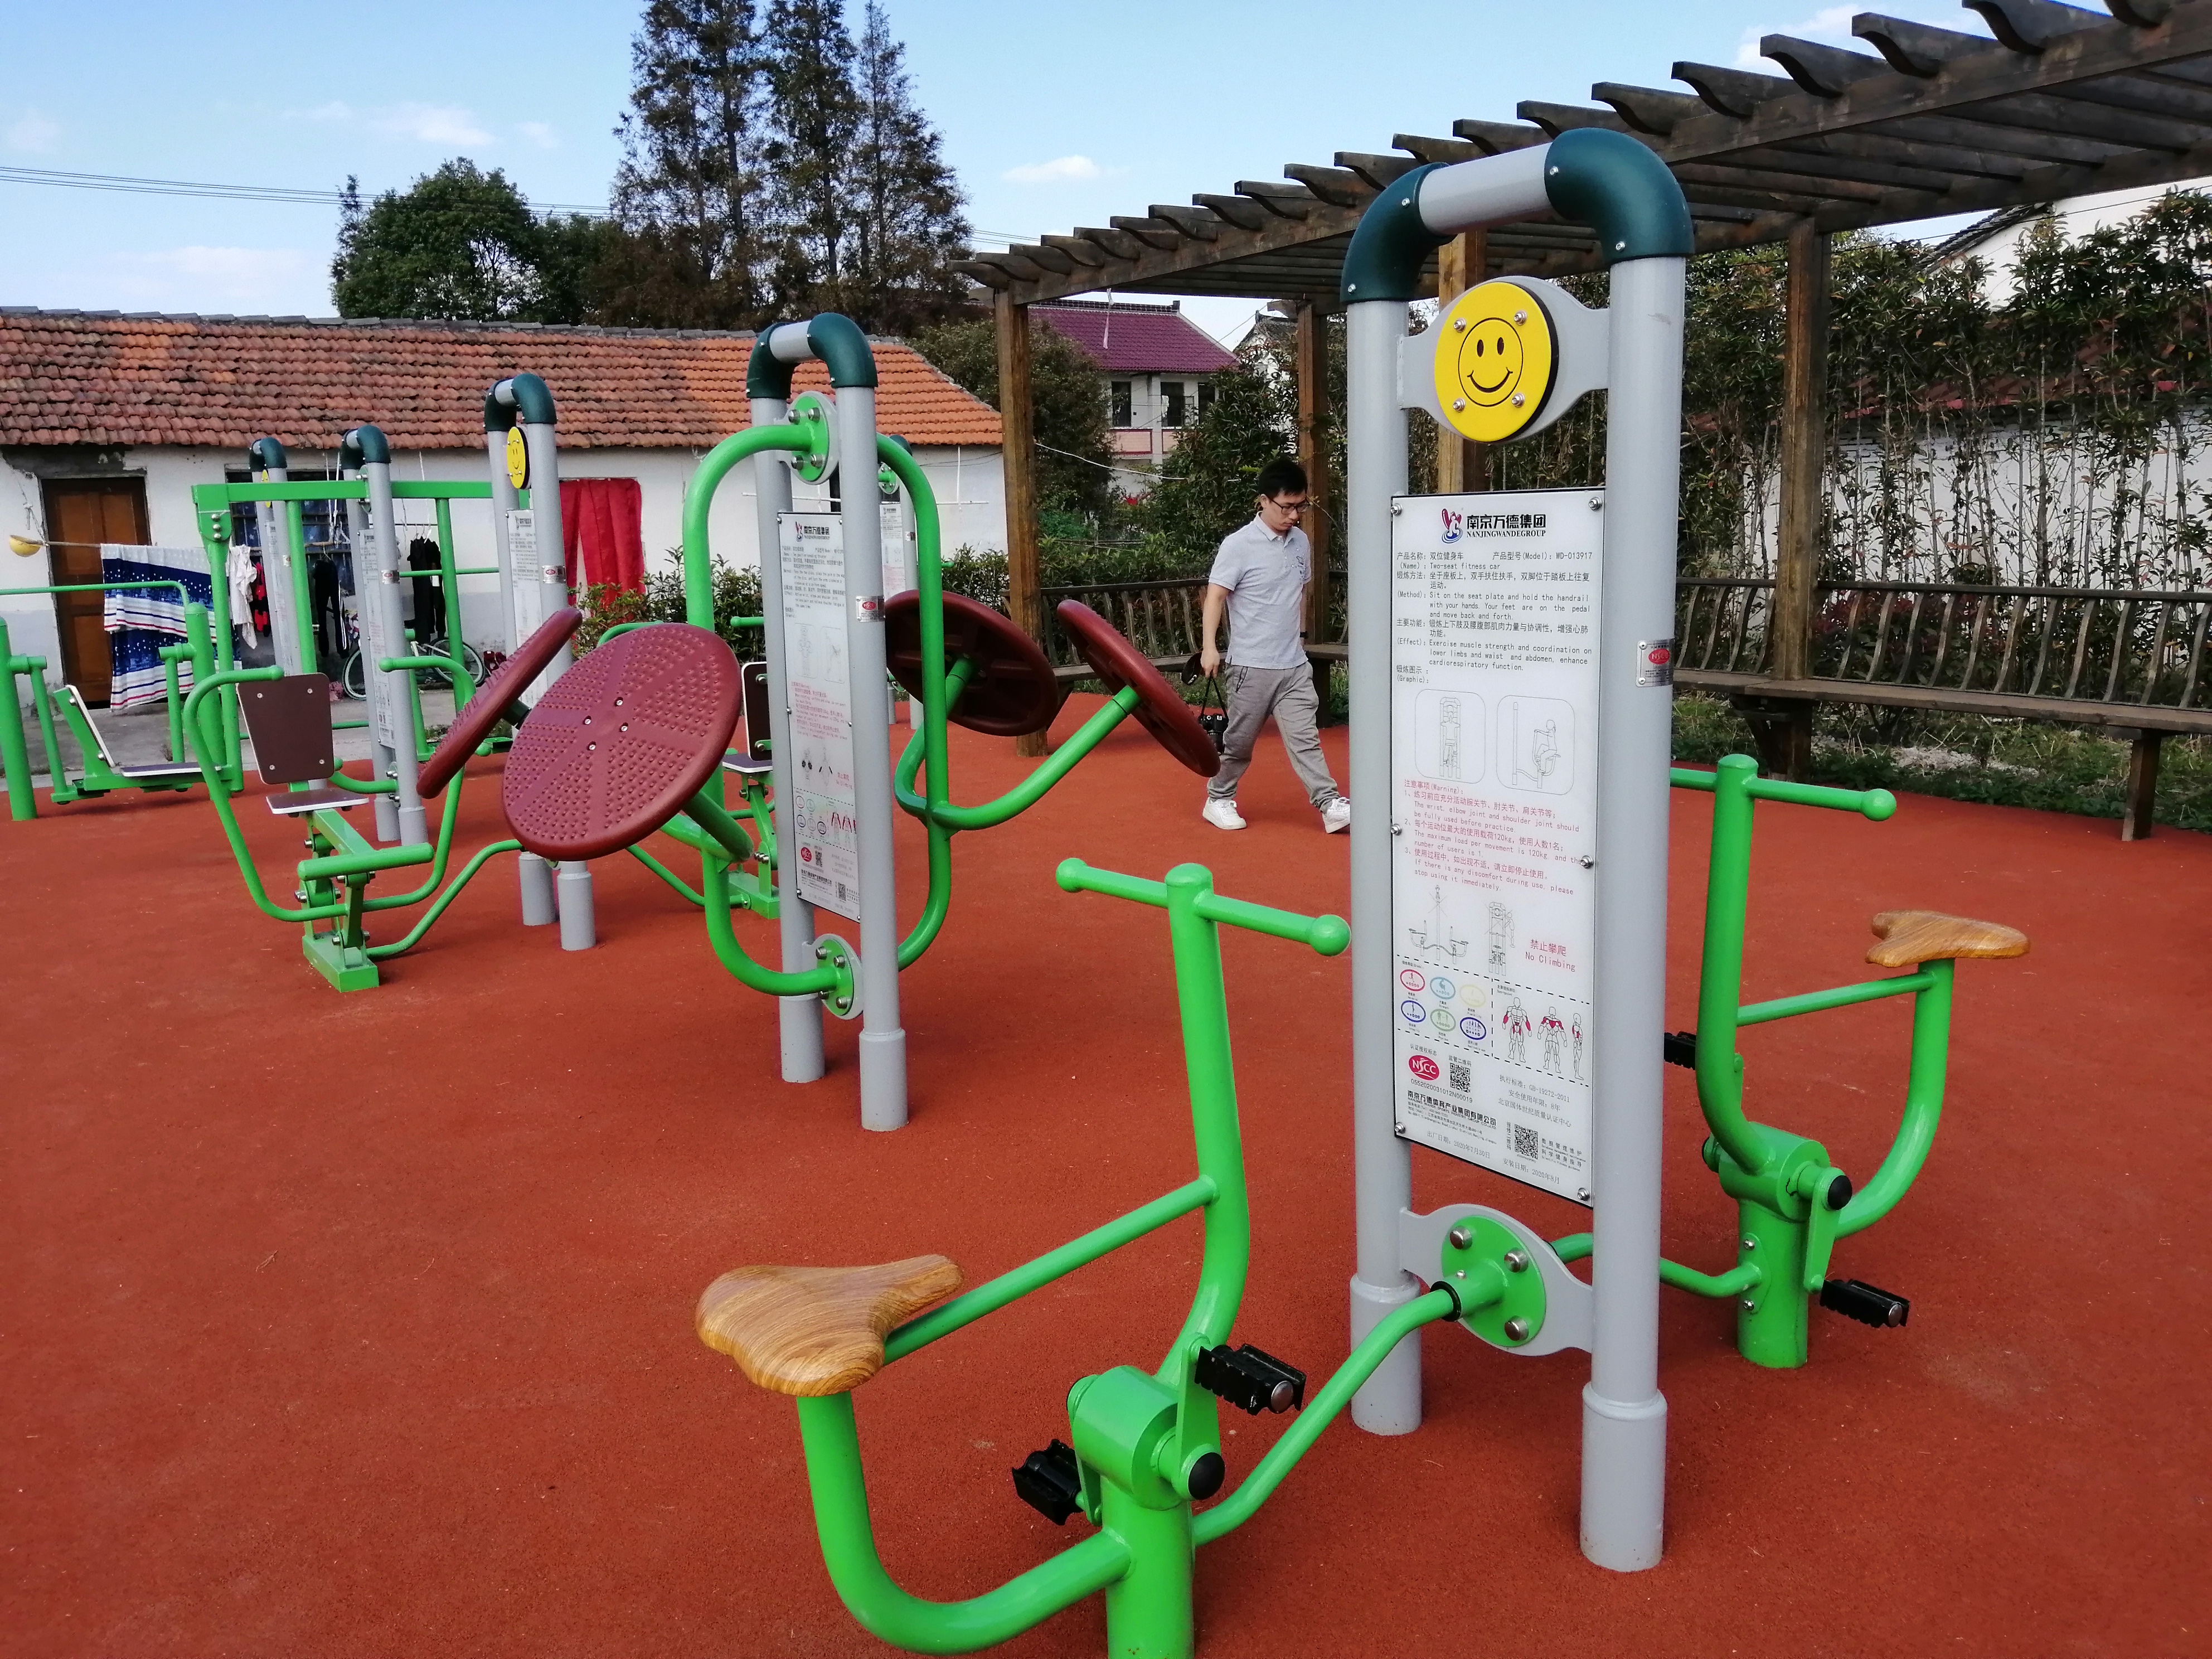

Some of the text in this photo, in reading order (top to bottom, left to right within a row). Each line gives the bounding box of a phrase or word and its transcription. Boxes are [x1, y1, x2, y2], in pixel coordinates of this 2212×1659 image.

[1467, 514, 1546, 530] 南京万德集团
[1396, 551, 1425, 560] 产品名称：
[1430, 551, 1463, 560] 双位健身车
[1396, 571, 1425, 579] 锻炼方法：
[1430, 581, 1446, 589] 运动。
[1396, 618, 1425, 627] 主要功能：
[1429, 629, 1445, 637] 功能。
[1532, 645, 1579, 653] coordination
[1429, 658, 1523, 671] cardiorespiratory function.
[1424, 812, 1440, 821] fully
[1461, 817, 1481, 827] before
[1485, 823, 1515, 832] practice.
[1449, 806, 1466, 814] elbow
[1469, 809, 1486, 818] joint
[1502, 814, 1531, 824] shoulder
[1535, 819, 1553, 828] joint
[1556, 823, 1579, 832] should
[1455, 836, 1467, 845] load
[1485, 843, 1513, 853] movement
[1430, 872, 1447, 881] using
[1462, 877, 1501, 891] immediately.
[1467, 869, 1502, 881] discomfort
[1506, 876, 1528, 887] during
[1550, 885, 1573, 895] please
[1530, 938, 1566, 957] 禁止攀爬
[1525, 951, 1575, 972] No Climbing
[1410, 1078, 1472, 1103] 0552020031012N00019
[1550, 1103, 1560, 1112] 8年
